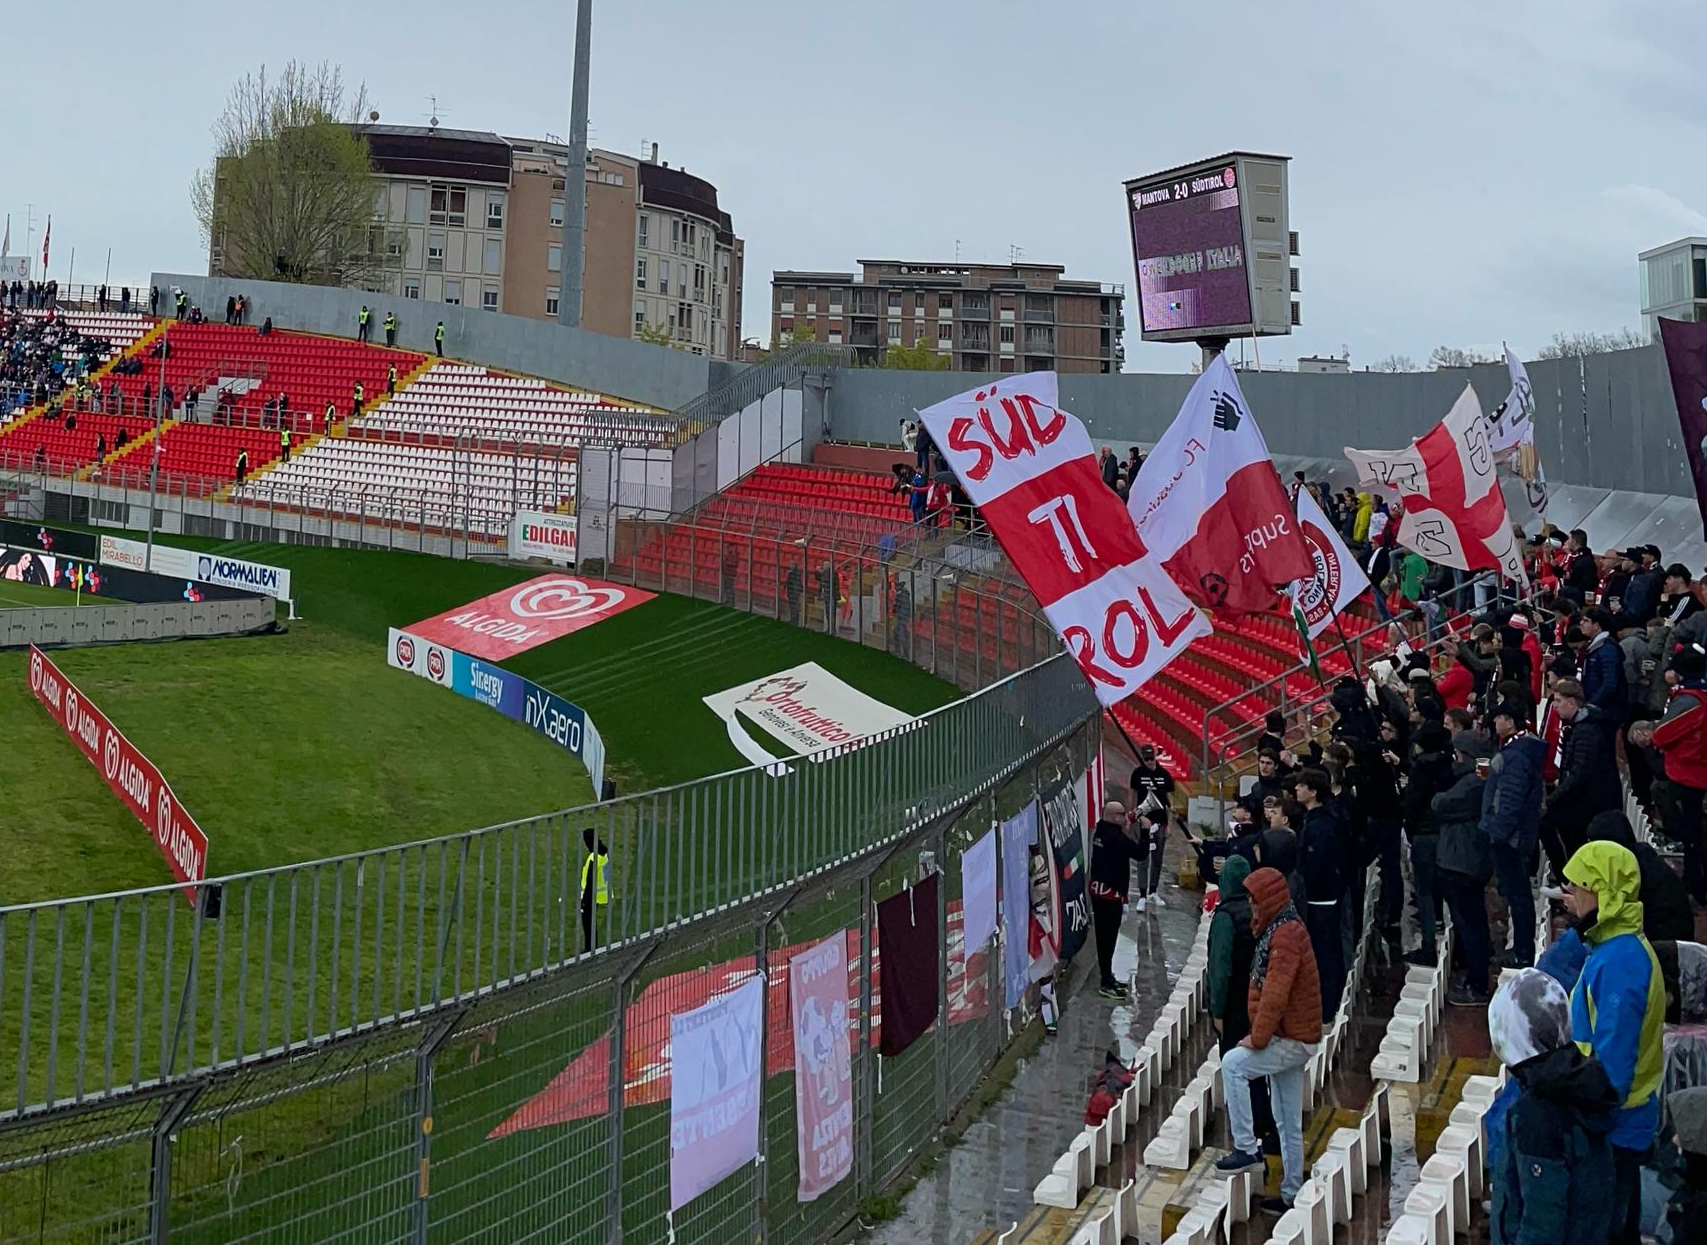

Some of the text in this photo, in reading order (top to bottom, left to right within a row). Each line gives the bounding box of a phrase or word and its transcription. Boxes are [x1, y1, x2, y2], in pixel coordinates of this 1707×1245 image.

[1141, 174, 1224, 206] MANTOVA 2-0 SÜDTIROL
[947, 385, 1067, 483] SÜD
[102, 538, 117, 550] EDIL
[522, 524, 576, 549] EDILGAM
[1027, 493, 1100, 574] TI
[102, 548, 143, 566] MIRABELLO
[212, 559, 277, 588] NORMALIEN
[444, 611, 541, 645] ALGIDA
[1062, 586, 1196, 692] ROL
[42, 670, 61, 712] ALGIDA
[470, 662, 504, 704] Sinergy
[78, 709, 100, 754] ALGIDA
[119, 756, 151, 813] ALGIDA
[171, 819, 198, 884] ALGIDA
